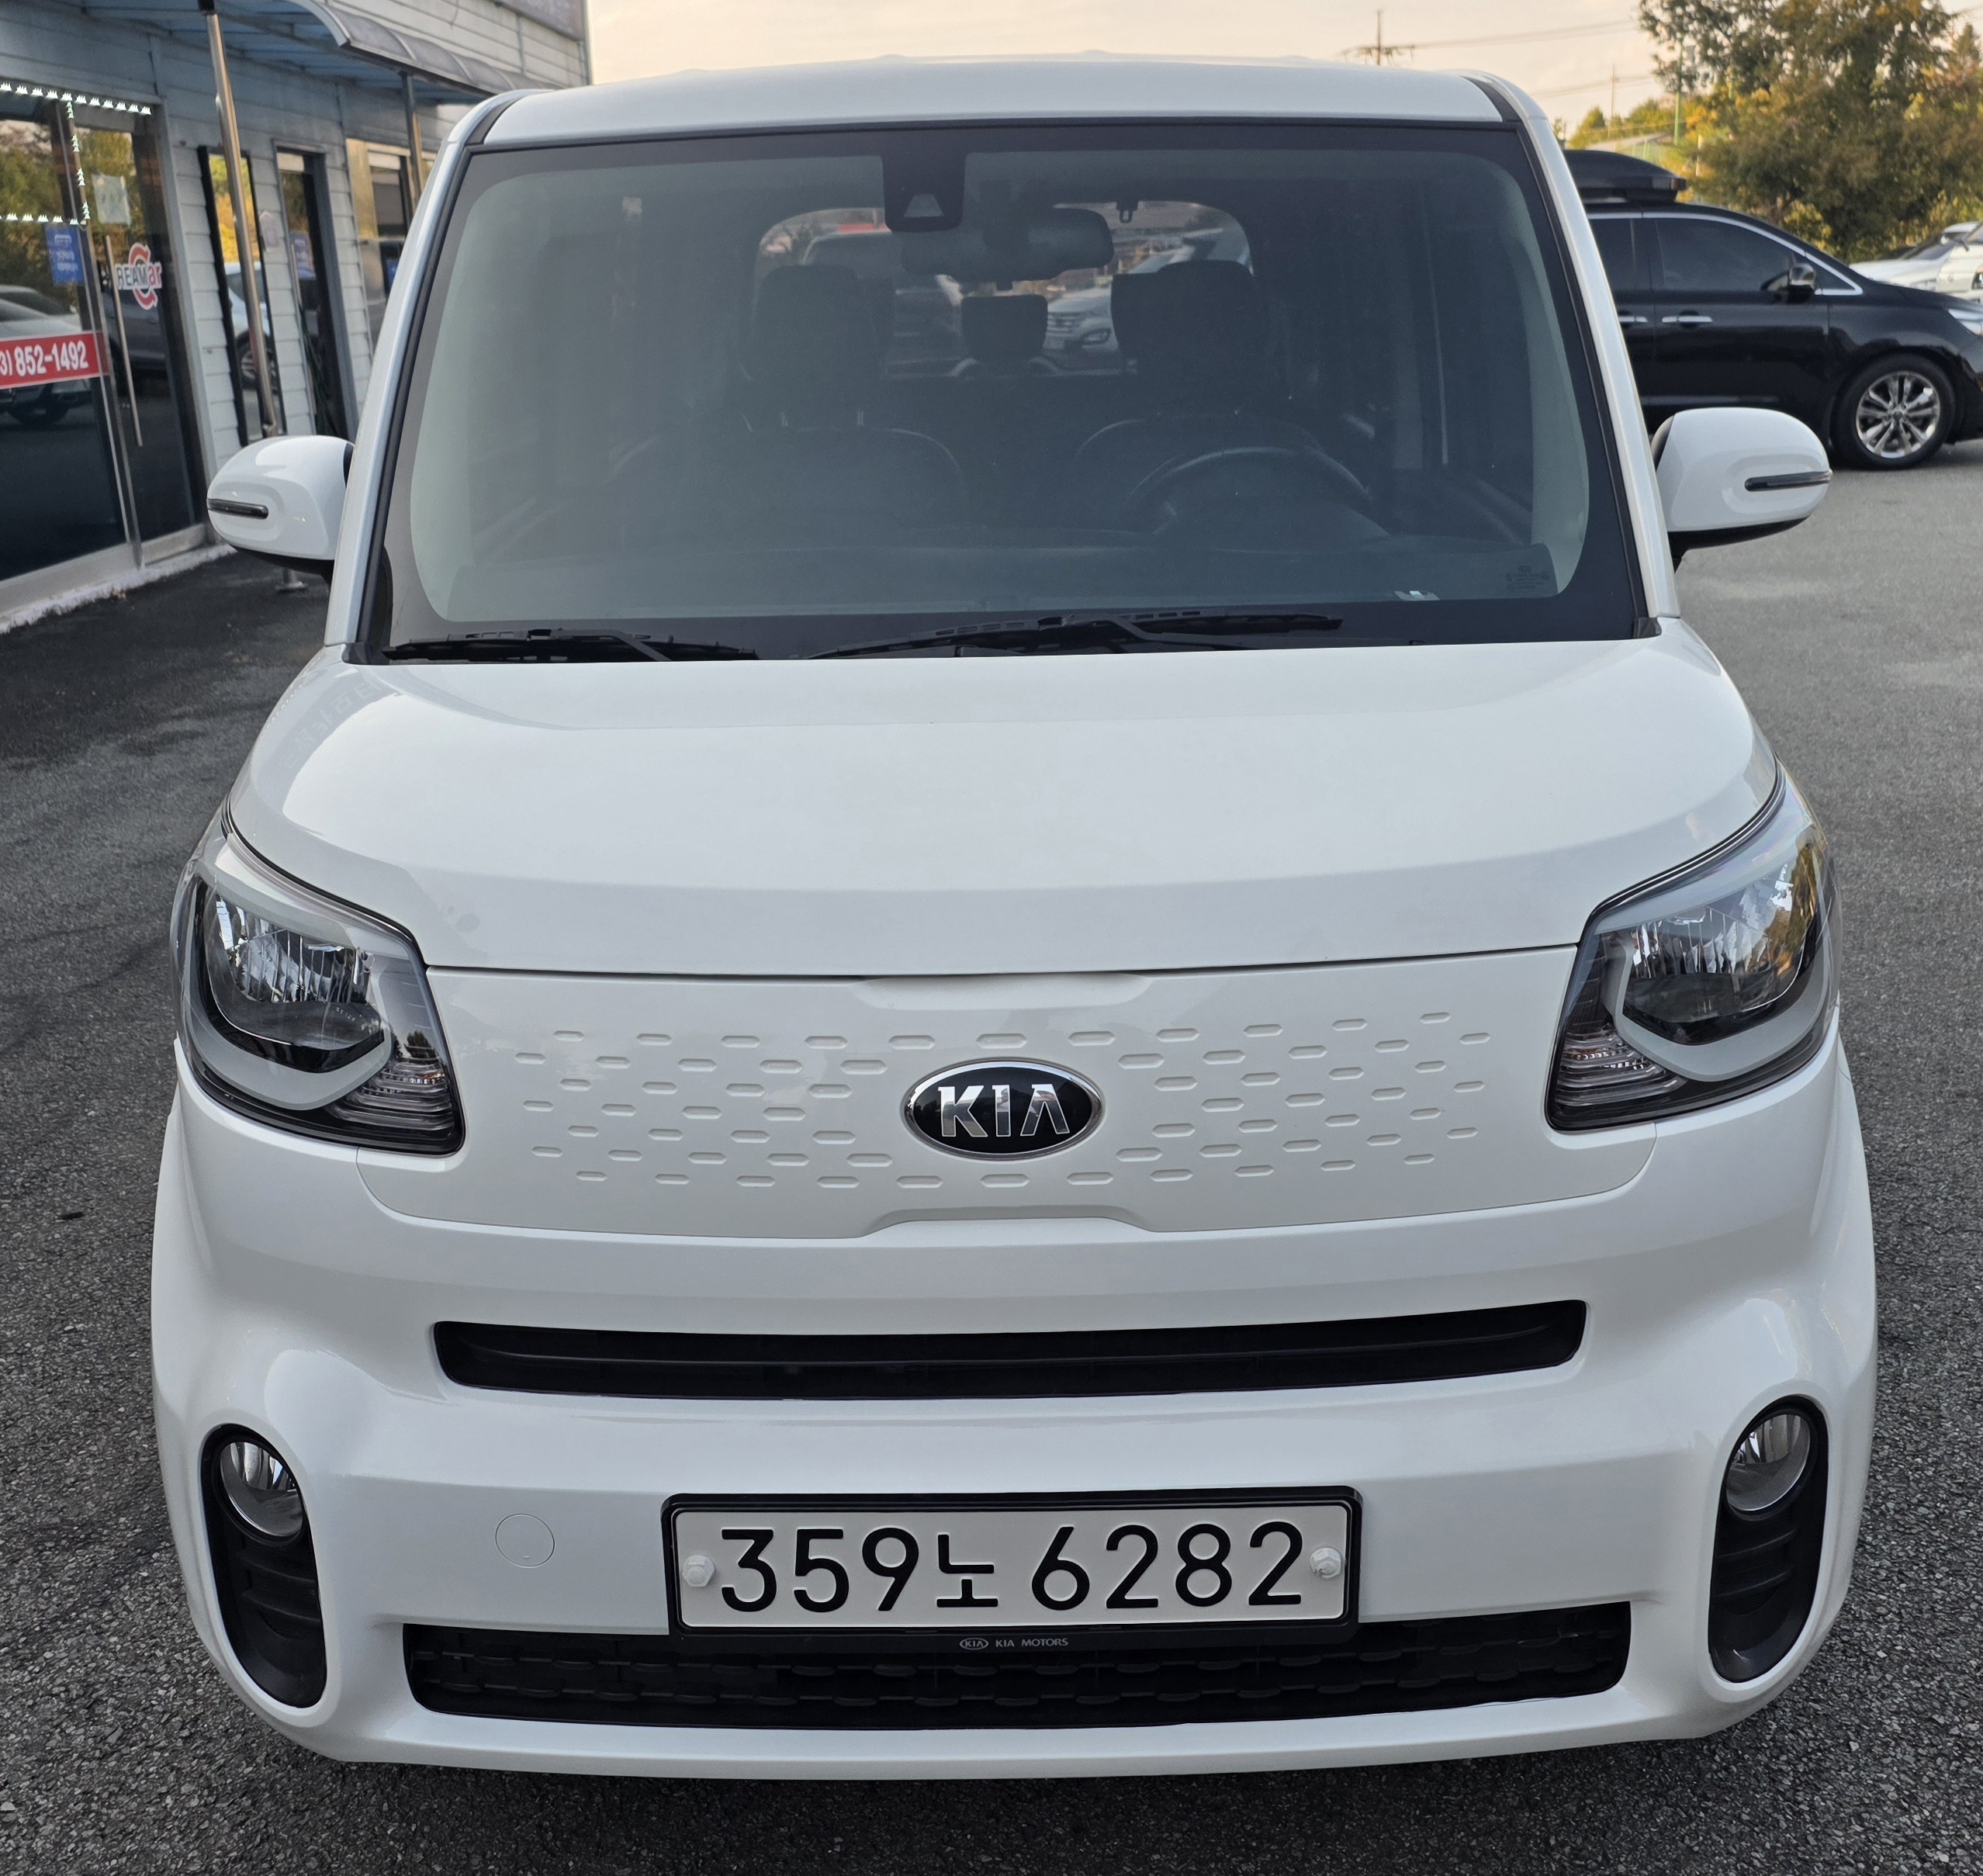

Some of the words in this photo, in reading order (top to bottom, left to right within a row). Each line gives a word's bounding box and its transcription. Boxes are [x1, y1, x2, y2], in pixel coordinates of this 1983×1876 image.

[14, 340, 89, 377] 852-1492
[937, 1083, 1071, 1138] KIA
[721, 1526, 999, 1613] 359노
[1031, 1521, 1304, 1611] 6282
[1021, 1638, 1069, 1647] MOTORS
